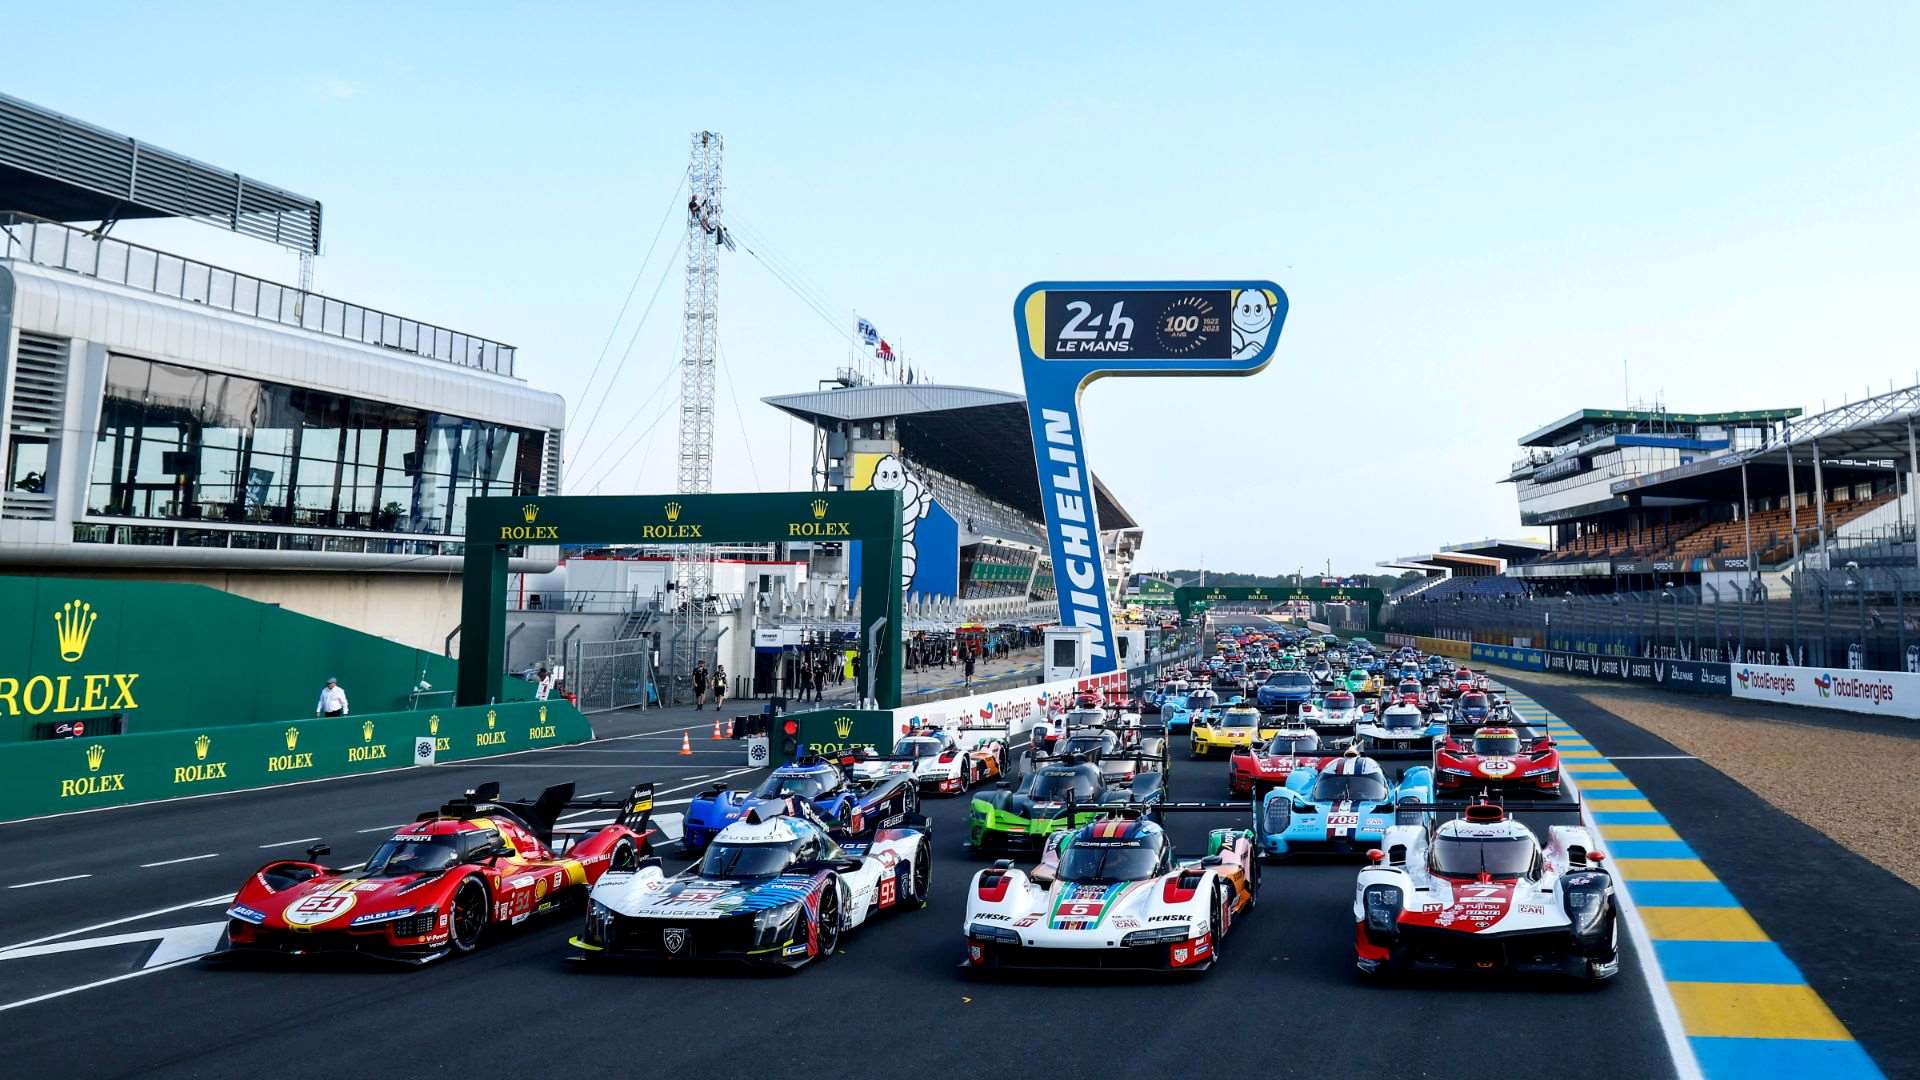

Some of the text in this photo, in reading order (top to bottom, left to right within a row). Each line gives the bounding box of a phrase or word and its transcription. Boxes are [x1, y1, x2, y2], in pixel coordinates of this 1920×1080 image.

[1059, 300, 1135, 340] 24h
[1165, 315, 1199, 333] 100
[1056, 341, 1129, 352] LE MANS
[501, 526, 559, 540] ROLEX
[642, 524, 702, 539] ROLEX
[788, 522, 850, 537] ROLEX
[1041, 408, 1107, 658] MICHELIN
[1750, 671, 1796, 696] TotalEnergies
[1832, 677, 1894, 705] TotalEnergies
[0, 673, 139, 716] ROLEX
[994, 697, 1031, 724] TotalEnergies
[476, 731, 507, 747] ROLEX
[529, 725, 556, 740] ROLEX
[348, 743, 387, 762] ROLEX
[268, 752, 313, 773] ROLEX
[1486, 762, 1507, 770] 50
[174, 762, 227, 784] ROLEX
[61, 773, 125, 798] ROLEX
[1330, 815, 1357, 824] 708
[881, 882, 896, 905] 93
[1466, 888, 1499, 898] 7
[300, 897, 344, 912] 51
[1070, 904, 1089, 914] 5
[1423, 904, 1442, 912] HY
[1521, 907, 1543, 915] CAR
[355, 913, 389, 922] ADLER
[638, 909, 720, 917] PEUGEOT
[974, 912, 1012, 922] PENSKE
[1147, 914, 1193, 923] PENSKE
